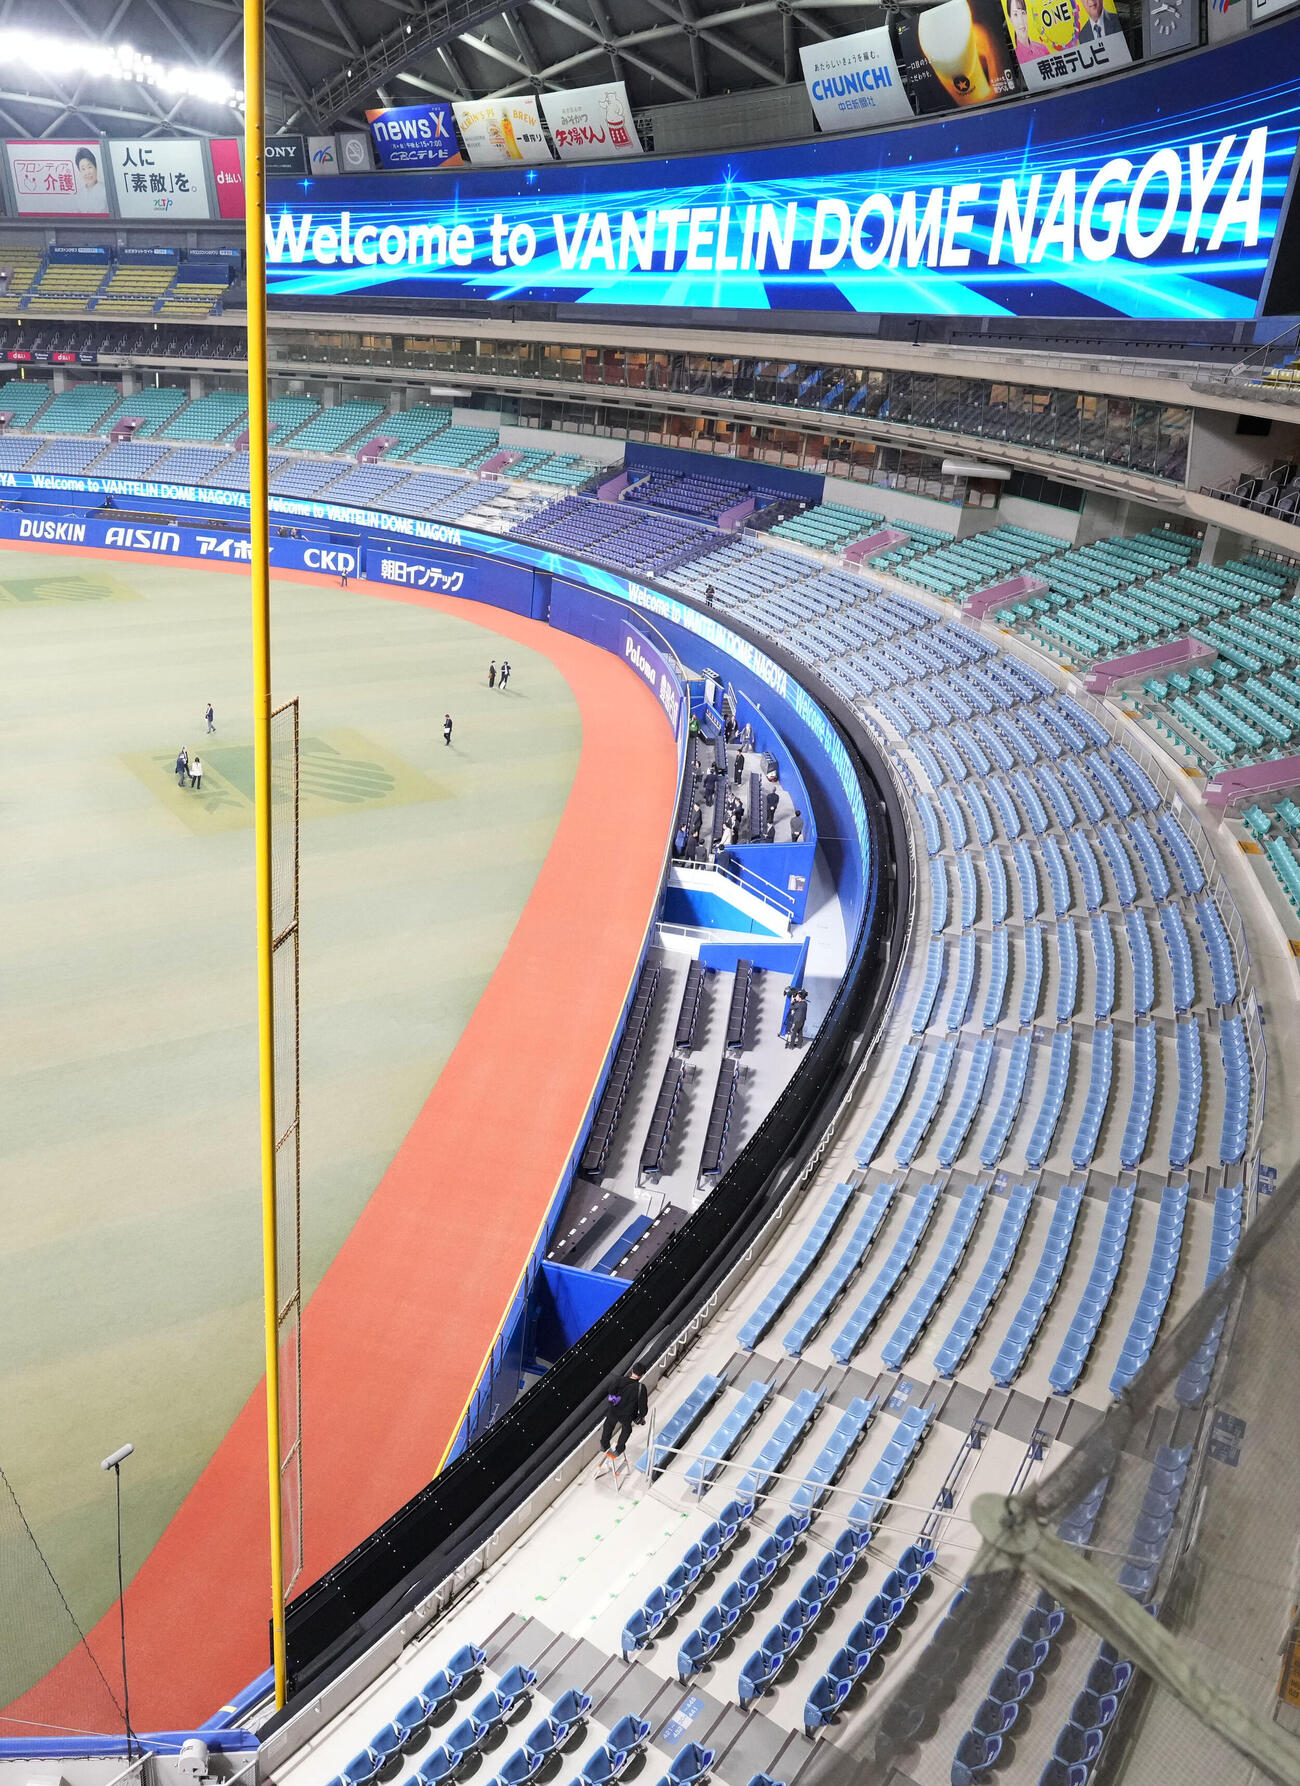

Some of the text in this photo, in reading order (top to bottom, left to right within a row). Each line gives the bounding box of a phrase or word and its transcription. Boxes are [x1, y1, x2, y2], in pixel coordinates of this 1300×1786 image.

[1041, 3, 1071, 27] ONE
[1037, 41, 1110, 81] 東海テレビ
[811, 65, 893, 102] CHUNICHI
[838, 96, 876, 111] 中日新聞社
[513, 109, 537, 126] BREW
[555, 124, 606, 147] 矢場とん
[122, 147, 155, 167] 人に
[265, 146, 297, 158] ONY
[43, 173, 75, 192] 介護
[123, 172, 198, 194] 「素敵」を。
[265, 126, 1269, 271] Welcome to VANTELIN DOME NAGOYA
[31, 474, 248, 507] Welcome to VANTELIN DOME NAGOYA
[19, 519, 86, 542] DUSKIN
[312, 503, 324, 519] to
[326, 504, 379, 529] VANTELIN
[380, 513, 414, 537] DOME
[415, 520, 462, 546] NAGOYA
[105, 527, 181, 552] AISIN
[303, 548, 355, 572] CKD
[381, 558, 464, 592] 朝日インテック
[628, 581, 670, 619] Welcome
[753, 647, 788, 699] NAGOYA
[625, 636, 657, 685] Paloma
